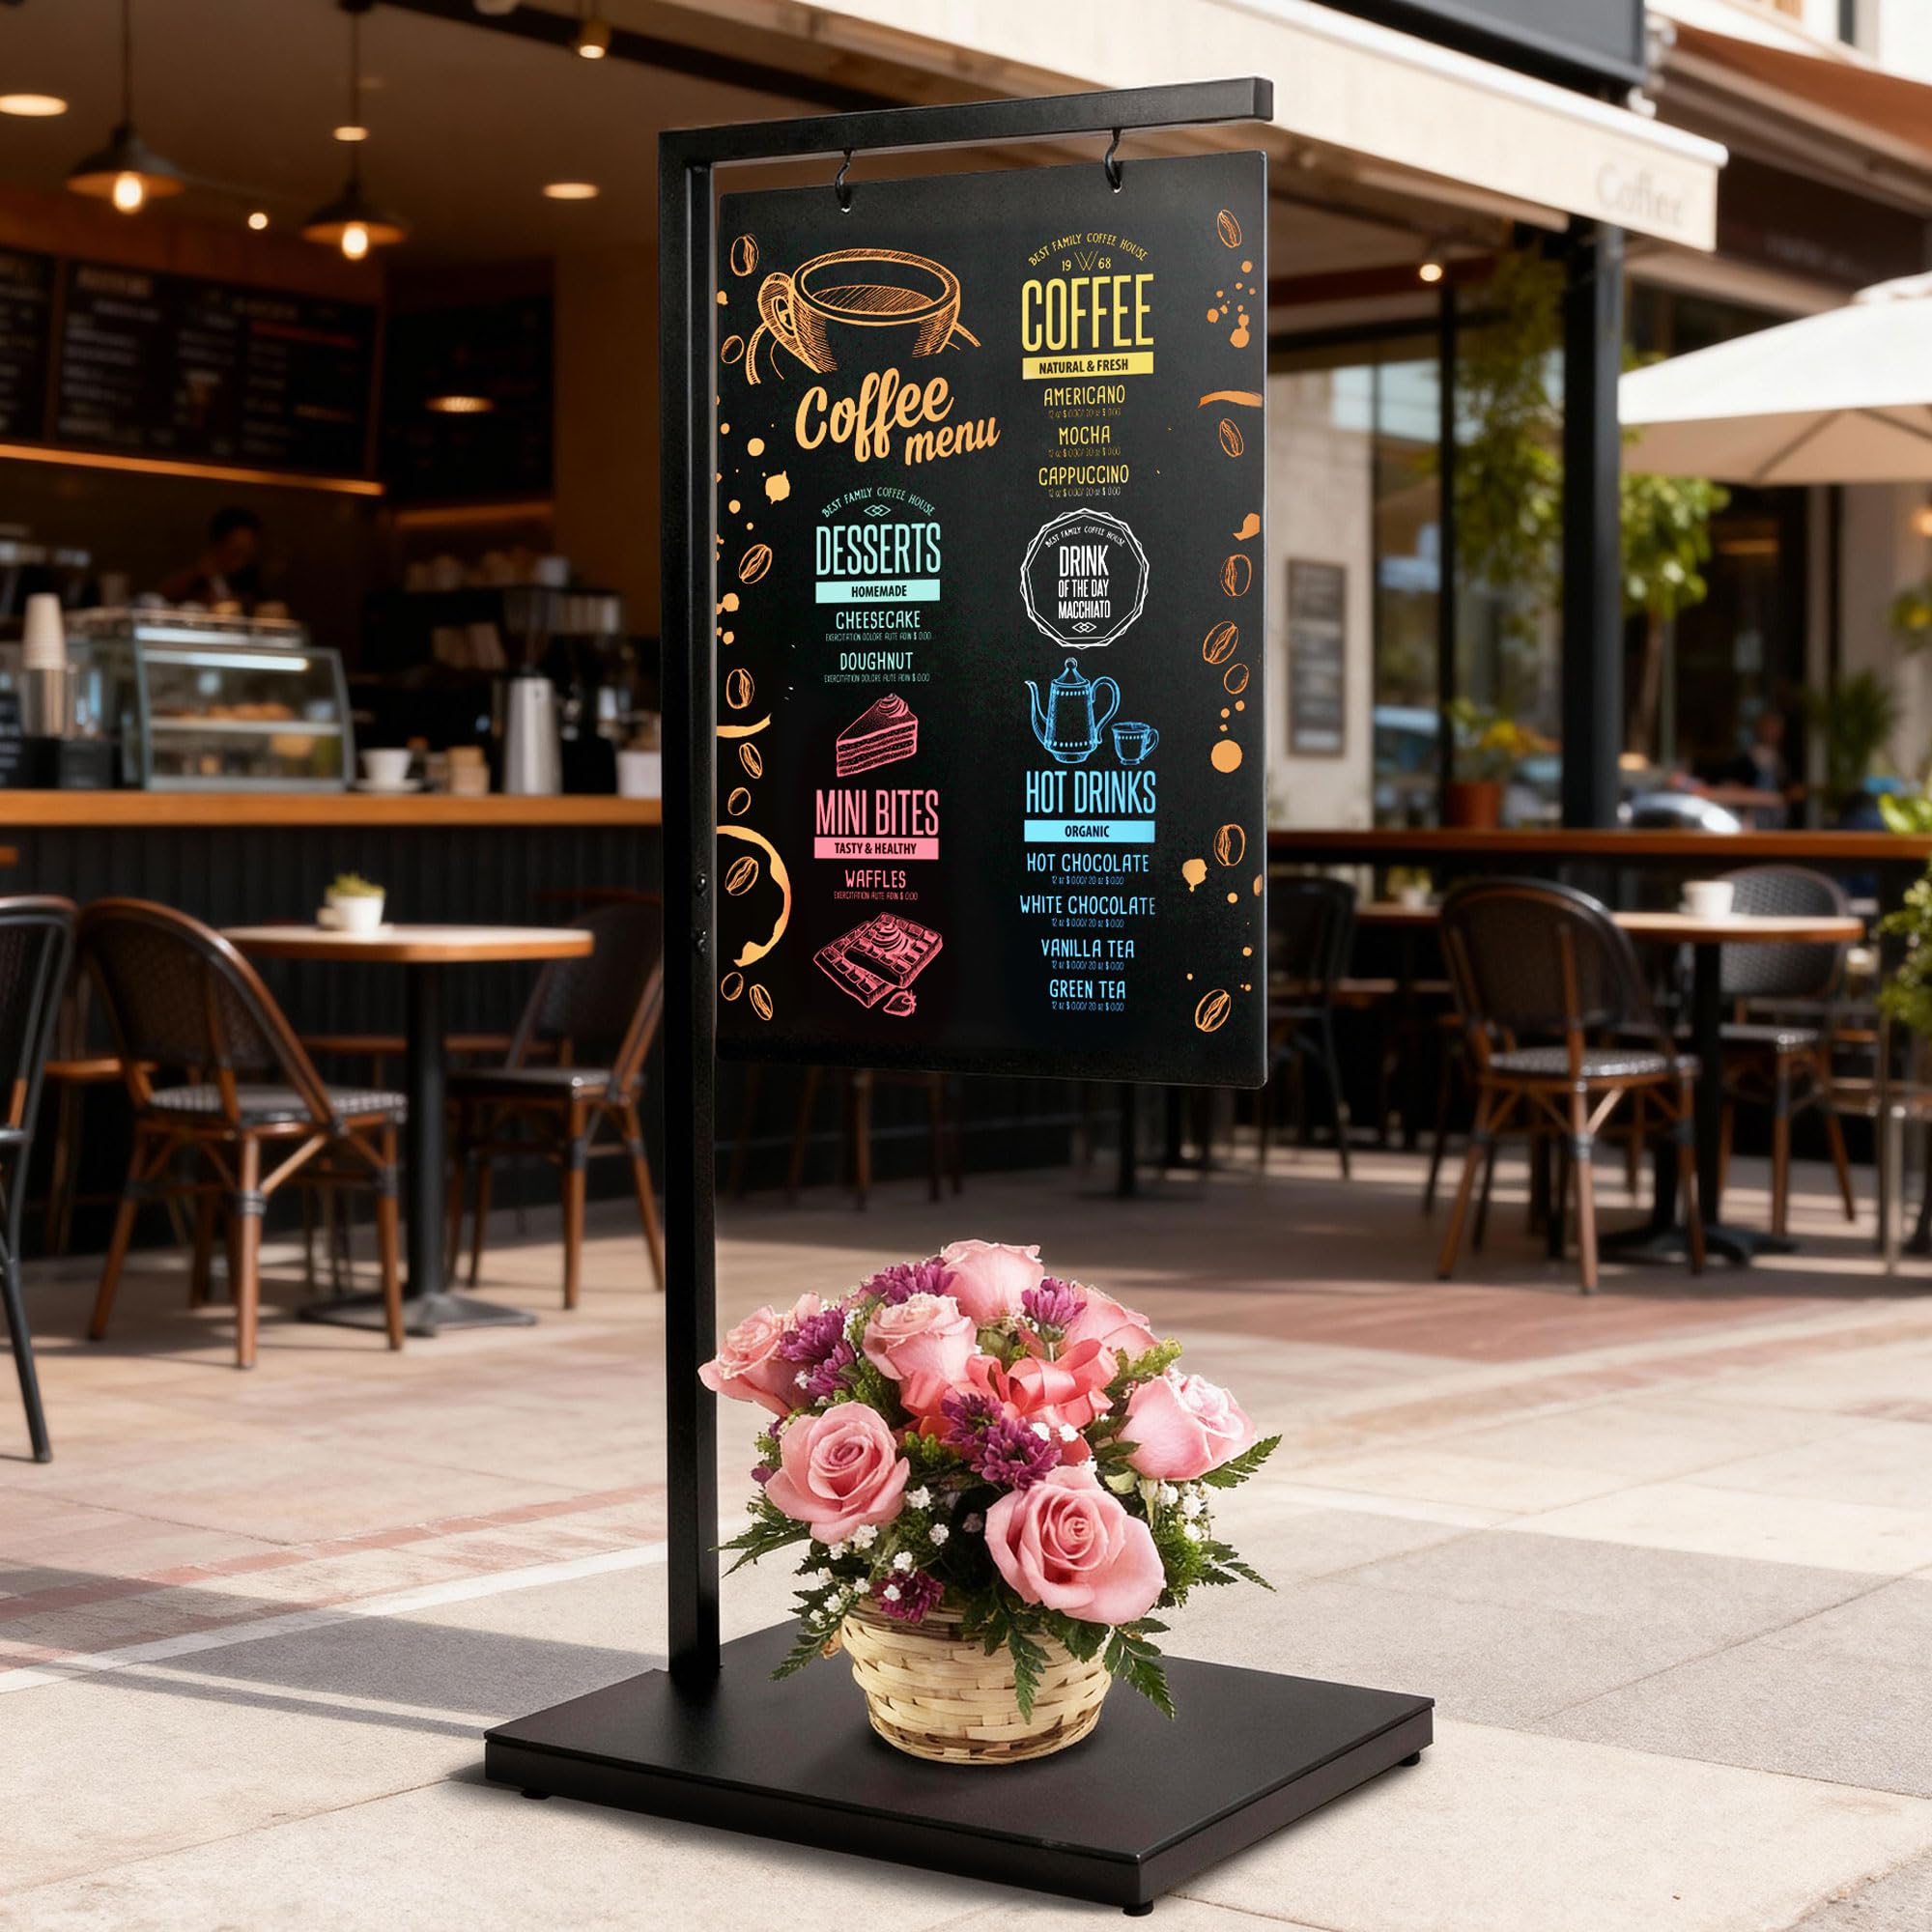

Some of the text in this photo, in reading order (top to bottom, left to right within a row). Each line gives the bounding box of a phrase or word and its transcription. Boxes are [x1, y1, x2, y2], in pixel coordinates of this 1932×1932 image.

[1028, 232, 1149, 267] BEST FAMILY COFFEE HOUSE
[1062, 259, 1071, 271] 19
[1097, 257, 1112, 270] 68
[1022, 273, 1154, 352] COFFEE
[1038, 358, 1128, 375] NATURAL & FRESH
[1043, 384, 1125, 407] AMERICANO
[795, 367, 954, 463] Coffee
[904, 416, 1001, 466] menu
[1059, 425, 1111, 445] MOCHA
[1038, 464, 1129, 486] CAPPUCCINO
[821, 487, 936, 518] BEST FAMILY COFFEE HOUSE
[1044, 533, 1060, 548] BEST
[1061, 526, 1081, 539] FAMILY
[1084, 526, 1105, 536] COFFEE
[816, 523, 941, 576] DESSERTS
[1059, 545, 1109, 577] DRINK
[851, 585, 907, 598] HOMEMADE
[1058, 579, 1109, 598] OF THE DAY
[1058, 600, 1111, 619] MACCHIATO
[836, 611, 921, 630] CHEESECAKE
[840, 651, 914, 670] DOUGHNUT
[1026, 770, 1156, 813] HOT DRINKS
[816, 789, 939, 836] MINI BITES
[1065, 825, 1110, 838] ORGANIC
[835, 842, 917, 855] TASTY & HEALTHY
[1027, 852, 1150, 873] HOT CHOCOLATE
[845, 869, 906, 889] WAFFLES
[1020, 895, 1156, 916] WHITE CHOCOLATE
[1040, 938, 1134, 958] VANILLA TEA
[1049, 979, 1126, 1000] GREEN TEA
